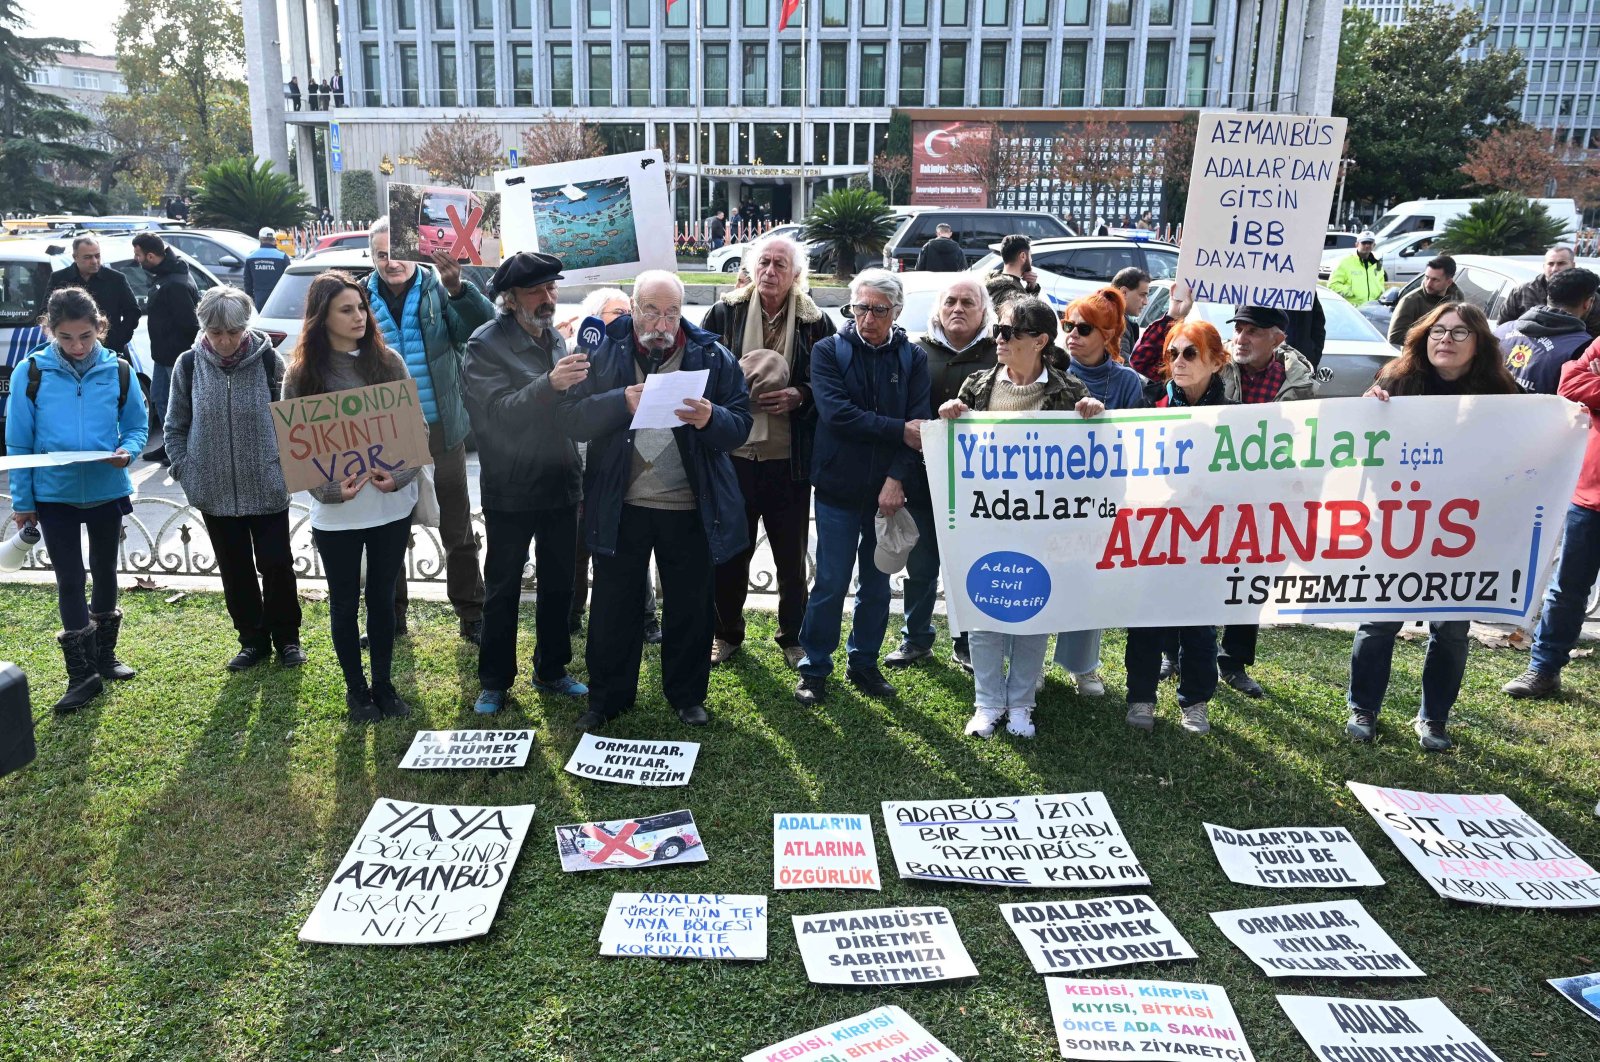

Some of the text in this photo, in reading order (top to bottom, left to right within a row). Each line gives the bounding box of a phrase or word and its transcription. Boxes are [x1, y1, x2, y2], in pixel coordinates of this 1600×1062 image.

[1211, 118, 1334, 147] AZMANBÜS
[1204, 156, 1333, 182] ADALAR'DAN
[1220, 184, 1298, 209] GİTSİN
[1229, 214, 1285, 246] İBB
[1195, 248, 1295, 274] DAYATMA
[1185, 278, 1314, 310] YALANI UZATMA
[275, 383, 413, 428] VİZYONDA
[289, 413, 398, 460] SIKINTI
[958, 418, 1444, 480] Yürünebilir Adalar için
[970, 490, 1117, 521] Adalar'da
[1096, 481, 1481, 569] AZMANBÜS
[980, 562, 1034, 574] Adalar
[991, 579, 1023, 590] Sivil
[595, 741, 684, 757] ORMANLAR,
[411, 755, 518, 767] İSTİYORUZ
[576, 762, 686, 782] YOLLAR BİZİM
[604, 754, 670, 769] KIYILAR,
[1034, 797, 1094, 820] İZNİ
[1376, 789, 1519, 815] ADALAR
[378, 802, 514, 842] YAYA
[778, 816, 862, 830] ADALAR'IN
[919, 824, 968, 842] BİR
[981, 826, 1033, 841] YIL
[355, 834, 522, 863] BÖLGESİNDE
[783, 841, 867, 857] ATLARINA
[1212, 828, 1352, 847] ADALAR'DA DA
[1410, 837, 1577, 861] KARAYOLU
[1249, 845, 1338, 865] YÜRÜ BE
[334, 860, 508, 892] AZMANBÜS
[779, 865, 875, 885] ÖZGÜRLÜK
[905, 861, 1027, 882] BAHANE
[1044, 864, 1116, 882] KALDI
[1254, 865, 1358, 884] İSTANBUL
[639, 893, 733, 905] ADALAR
[1432, 875, 1600, 900] KABUL EDİLME
[333, 892, 441, 915] ISRARI
[616, 905, 767, 919] TÜRKİYE'NİN TEK
[1011, 898, 1155, 924] ADALAR'DA
[624, 918, 753, 931] YAYA BÖLGESİ
[802, 909, 949, 934] AZMANBÜSTE
[1030, 918, 1162, 944] YÜRÜMEK
[1237, 909, 1360, 935] ORMANLAR,
[644, 930, 730, 943] BİRLİKTE
[835, 931, 934, 949] DİRETME
[1272, 934, 1368, 953] KIYILAR,
[616, 943, 737, 958] KORUYALIM
[828, 948, 946, 966] SABRIMIZI
[1040, 940, 1182, 968] İSTİYORUZ
[1260, 950, 1411, 971] YOLLAR BİZİM
[850, 965, 945, 983] ERİTME!
[1064, 984, 1210, 1001] KEDİSİ, KİRPİSİ
[1072, 1002, 1214, 1019] KIYISI, BİTKİSİ
[1327, 1002, 1424, 1034] ADALAR
[831, 1012, 894, 1041] KİRPİSİ
[1062, 1018, 1237, 1041] ÖNCE ADA SAKİNİ
[845, 1029, 910, 1058] BİTKİSİ
[1065, 1038, 1248, 1062] SONRA ZİYARETÇİ
